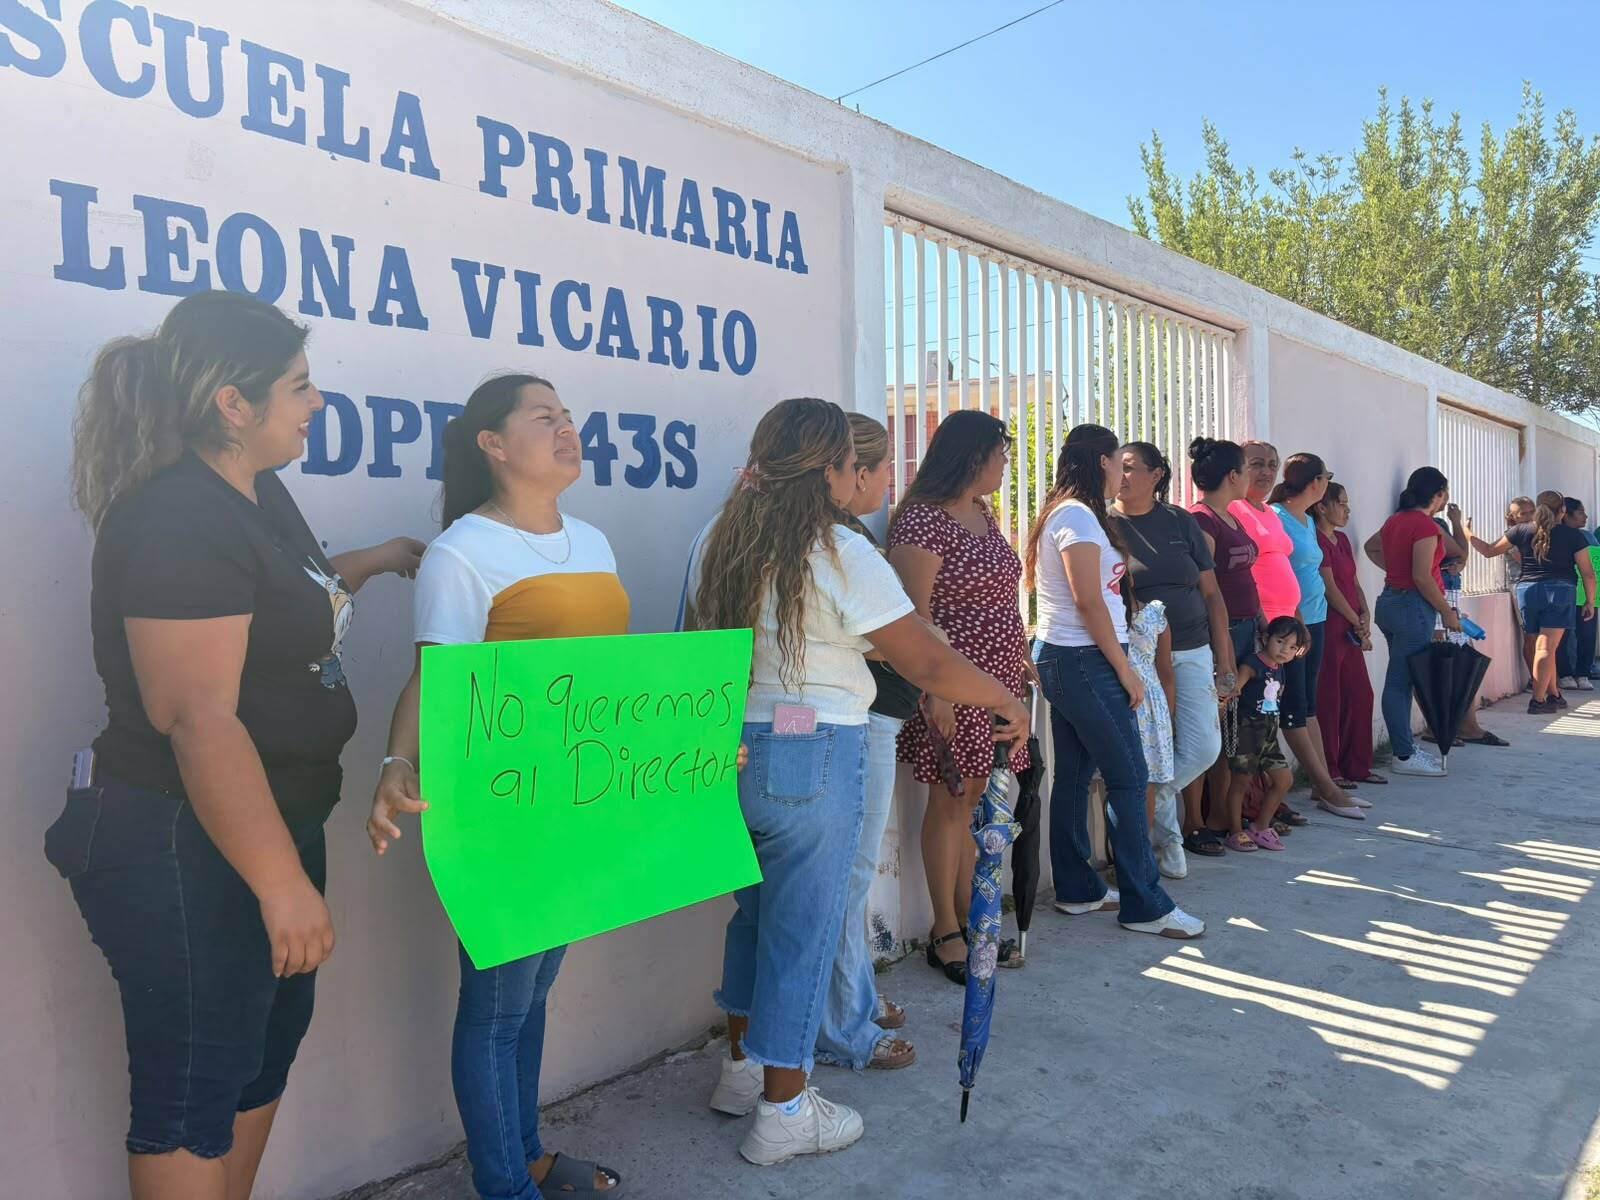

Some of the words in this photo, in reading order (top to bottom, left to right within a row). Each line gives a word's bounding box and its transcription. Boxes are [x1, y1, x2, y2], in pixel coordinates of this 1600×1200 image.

[476, 115, 809, 275] PRIMARIA
[49, 178, 429, 331] LEONA
[451, 258, 757, 376] VICARIO
[466, 648, 524, 759] No
[547, 673, 733, 747] queremos
[491, 765, 537, 807] al
[567, 739, 738, 806] Director
